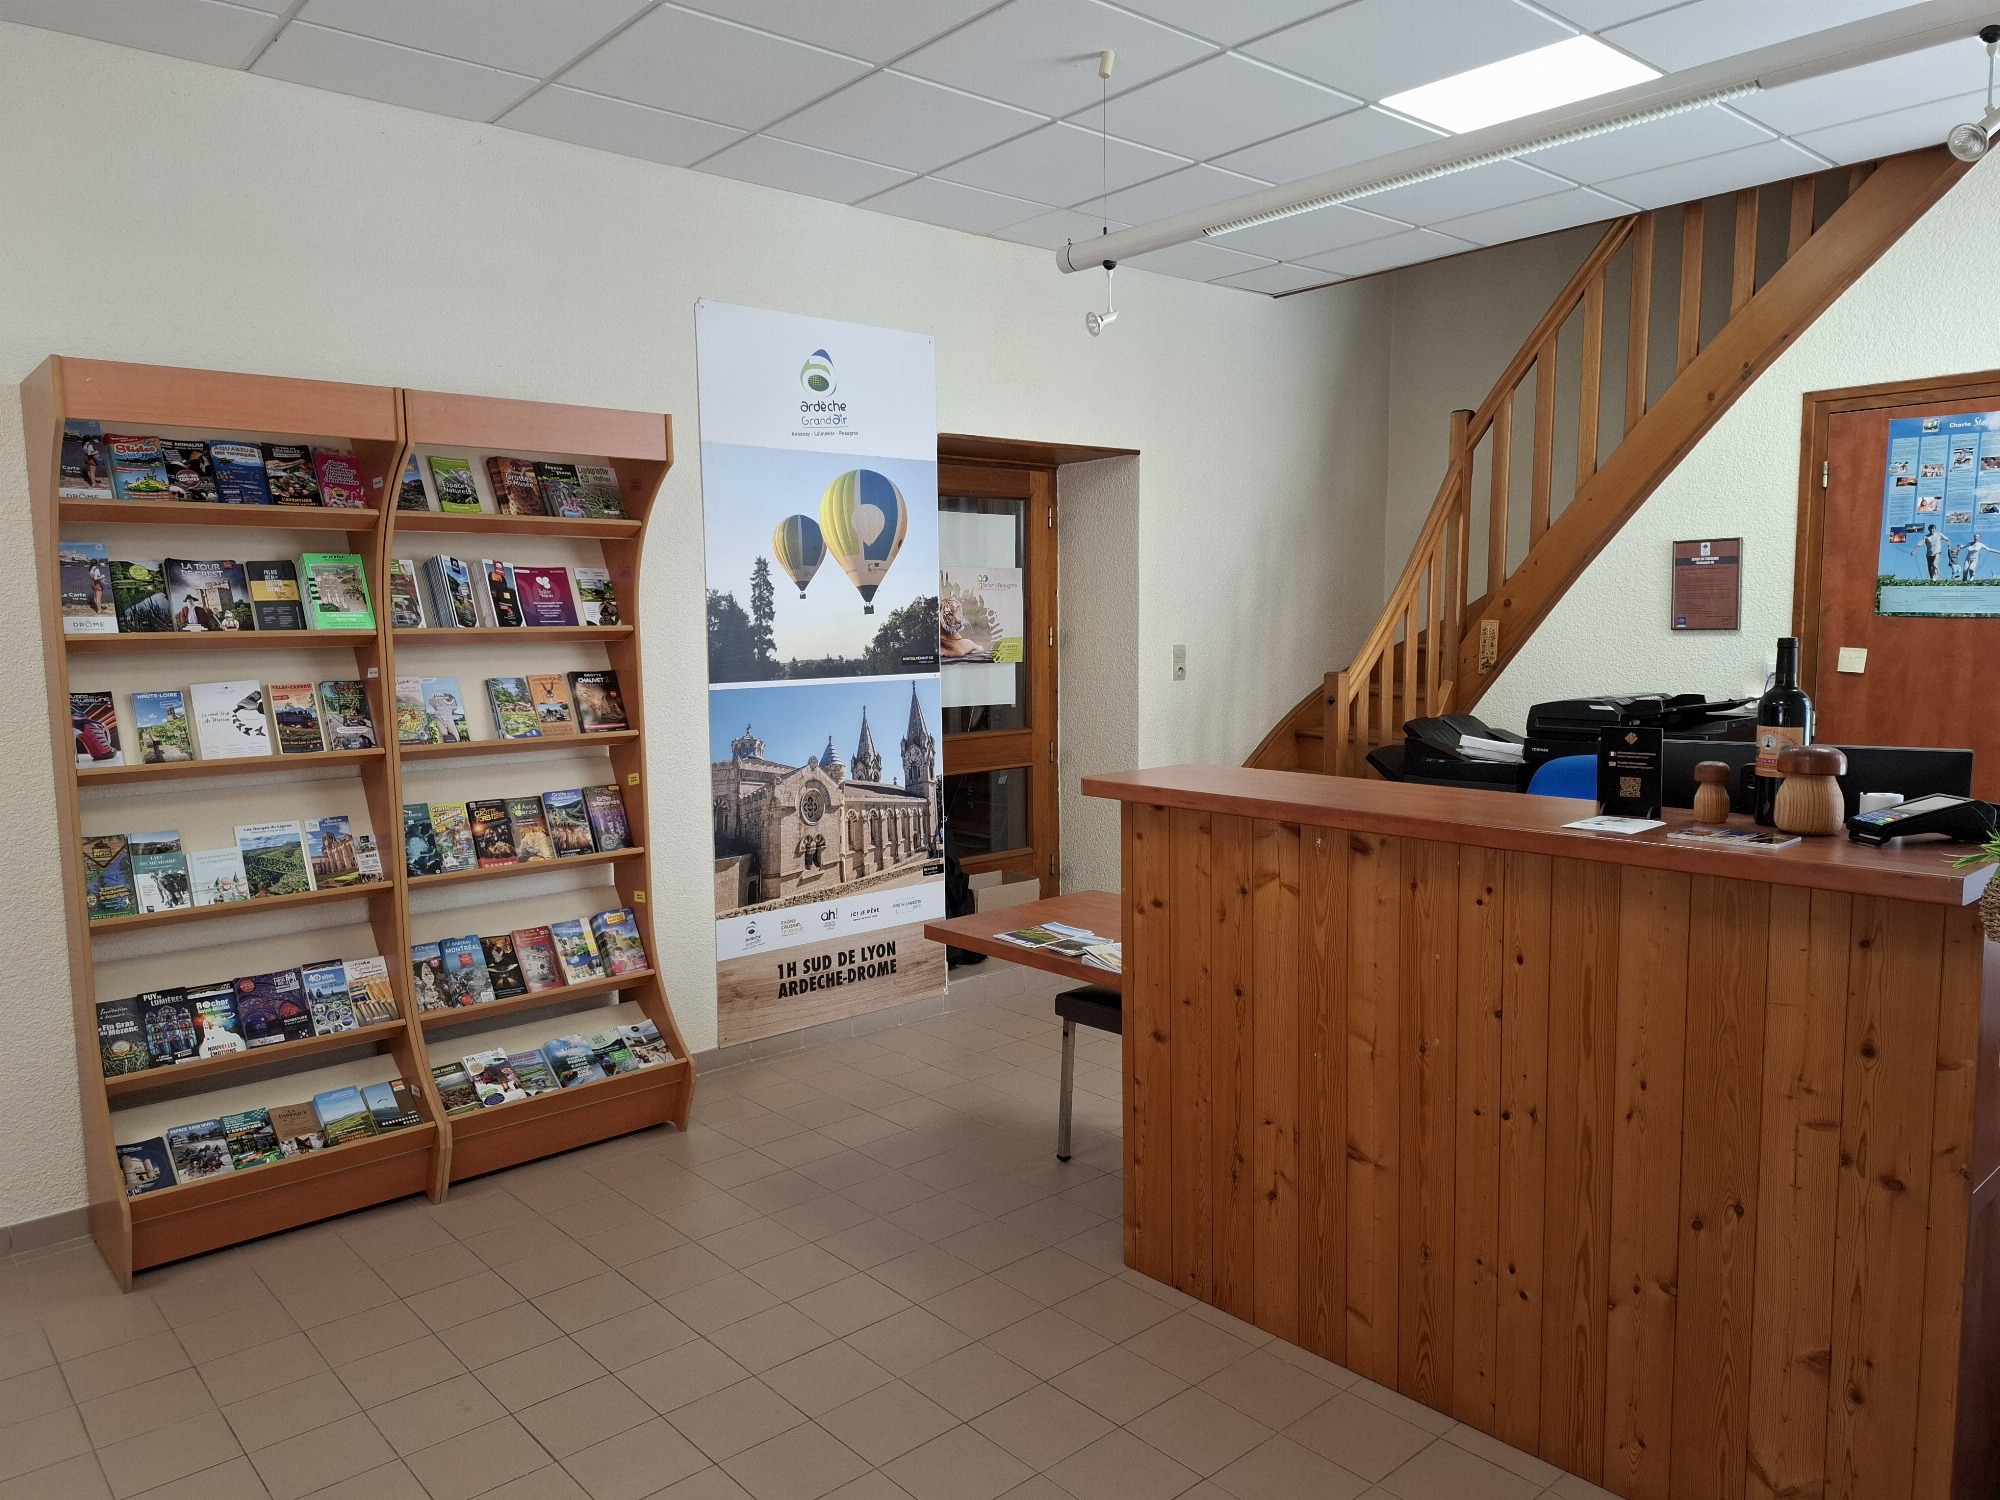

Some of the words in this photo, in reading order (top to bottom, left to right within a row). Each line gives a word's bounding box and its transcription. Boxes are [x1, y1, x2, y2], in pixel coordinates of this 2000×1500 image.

[800, 400, 847, 412] ardèche
[801, 415, 832, 426] Grand
[181, 562, 193, 570] LA
[195, 563, 221, 571] TOUR
[194, 570, 224, 578] CREST
[73, 619, 105, 628] DRÔME
[820, 908, 838, 921] ah!
[451, 938, 473, 947] CHÂTEAU
[445, 943, 481, 954] MONTRÉAL
[777, 961, 797, 980] 1H
[803, 954, 832, 974] SUD
[838, 949, 856, 967] DE
[861, 941, 896, 962] LYON
[321, 973, 335, 981] sites
[777, 958, 897, 999] ARDECHE-DROME
[143, 993, 157, 1001] PUY
[150, 995, 184, 1007] LUMIÈRES
[115, 1021, 135, 1029] Gras
[207, 1041, 237, 1052] NOUVELLES
[209, 1047, 237, 1058] ÉMOTIONS
